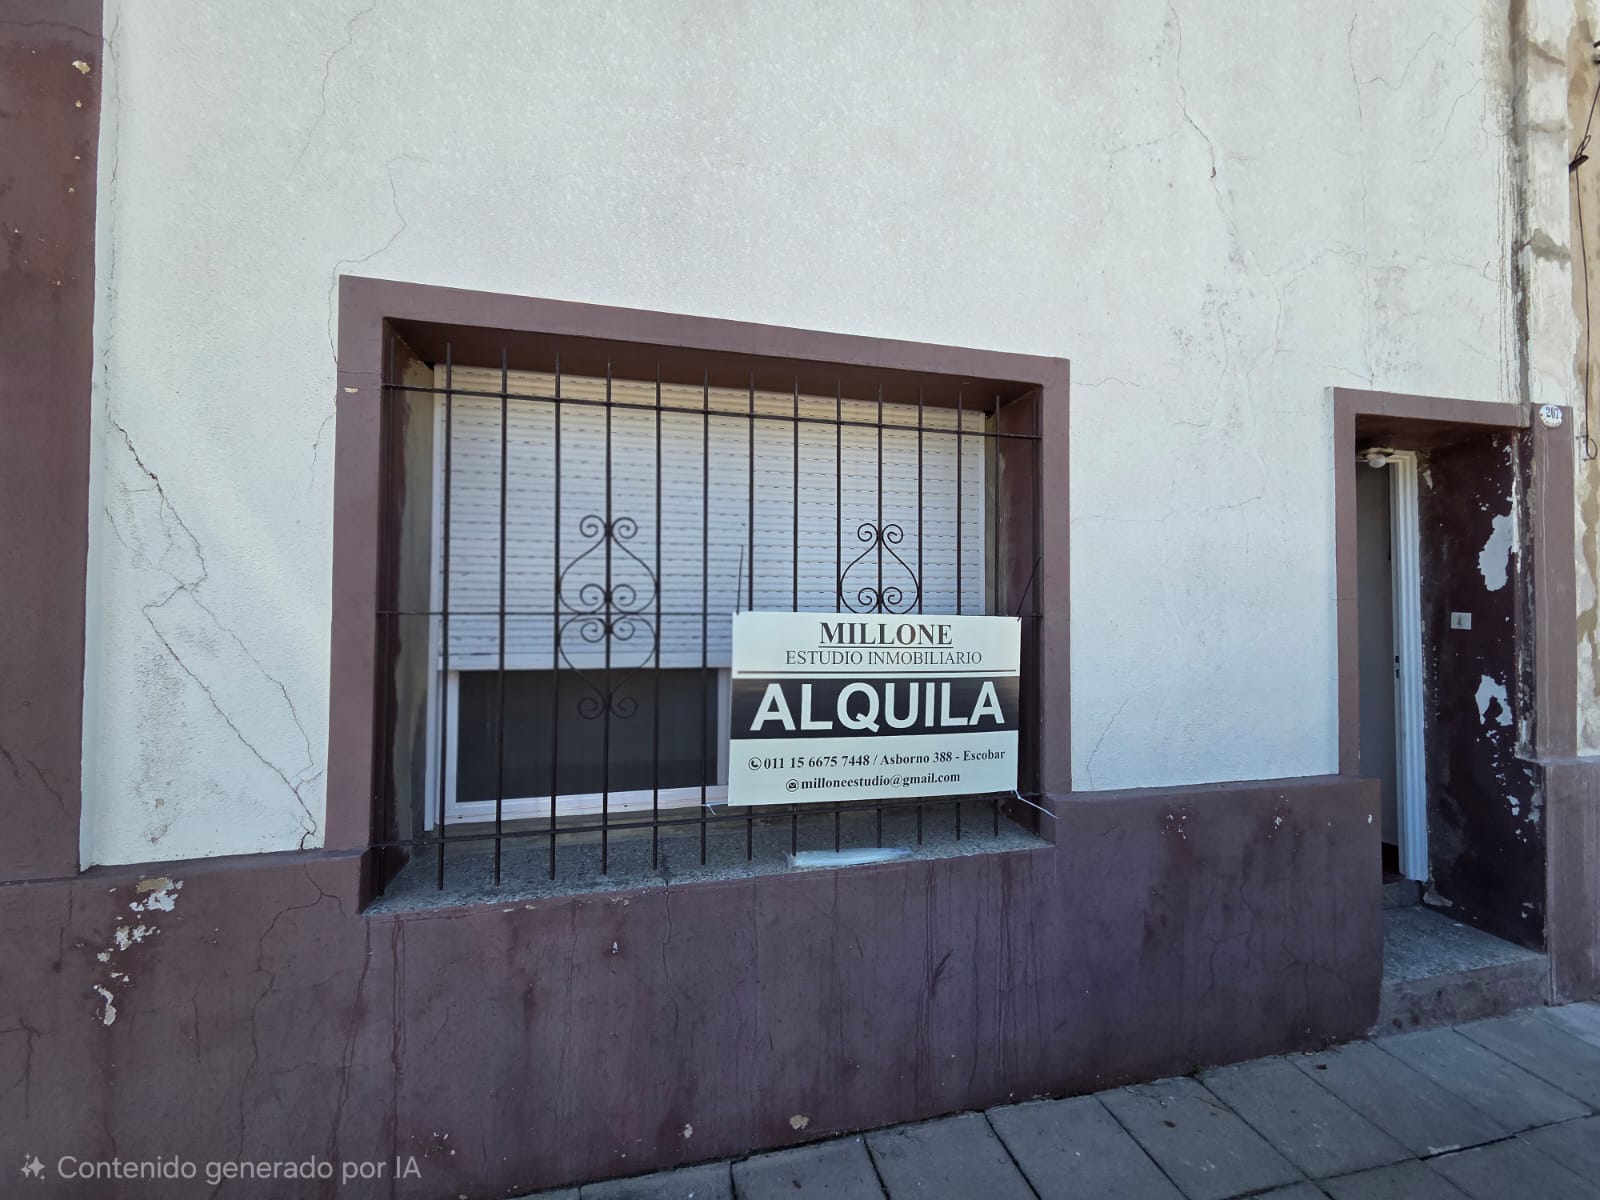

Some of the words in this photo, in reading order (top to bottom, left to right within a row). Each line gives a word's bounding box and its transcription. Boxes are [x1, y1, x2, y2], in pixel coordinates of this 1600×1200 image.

[819, 622, 953, 645] MILLONE
[785, 650, 863, 665] ESTUDIO
[868, 651, 982, 665] INMOBILIARIO
[749, 681, 1006, 733] ALQUILA
[764, 757, 785, 770] 011
[789, 757, 805, 769] 15
[808, 756, 838, 768] 6675
[841, 754, 870, 767] 7448
[872, 753, 878, 766] /
[880, 753, 930, 766] Asborno
[932, 751, 953, 763] 388
[963, 749, 1006, 761] Escobar
[800, 772, 961, 790] milloneestudio@gmail.com
